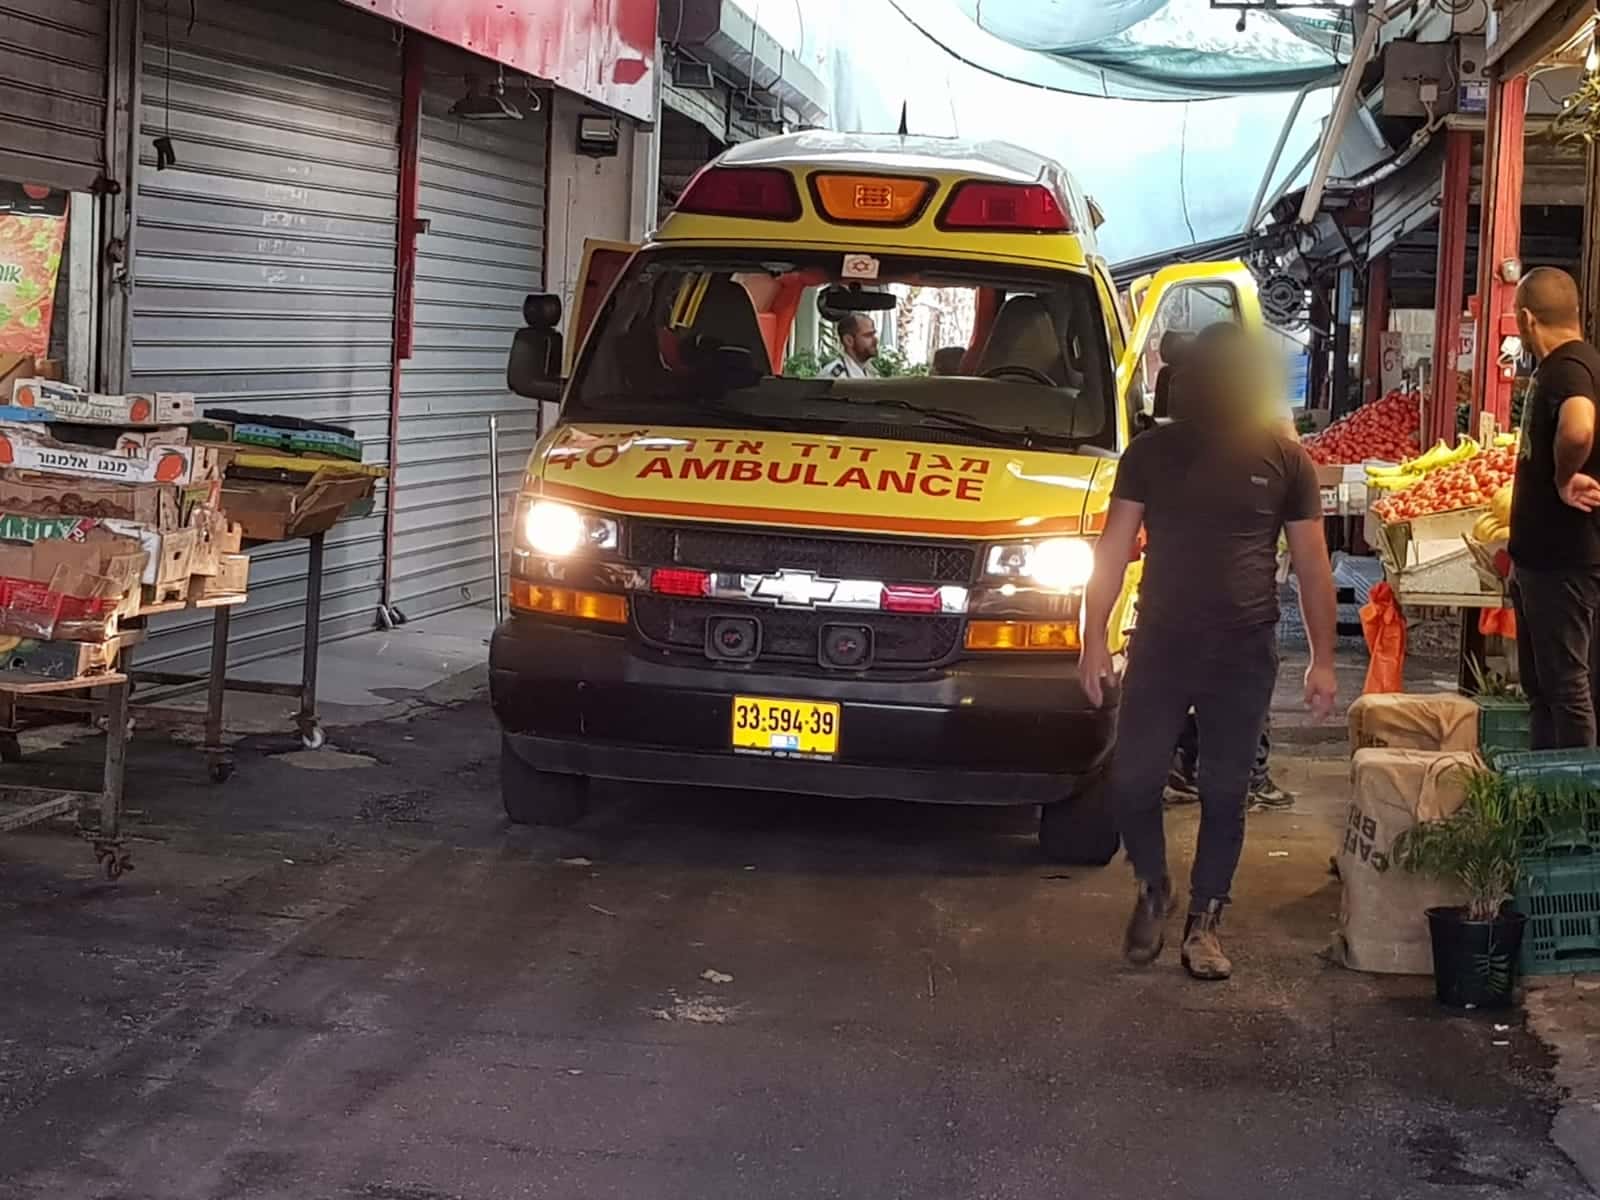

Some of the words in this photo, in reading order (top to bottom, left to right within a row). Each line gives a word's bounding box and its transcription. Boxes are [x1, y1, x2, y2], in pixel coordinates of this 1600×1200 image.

[36, 451, 89, 468] אלמגור
[791, 442, 878, 462] דוד
[97, 460, 128, 473] מנגו
[905, 451, 991, 475] מגן
[635, 457, 984, 502] AMBULANCE
